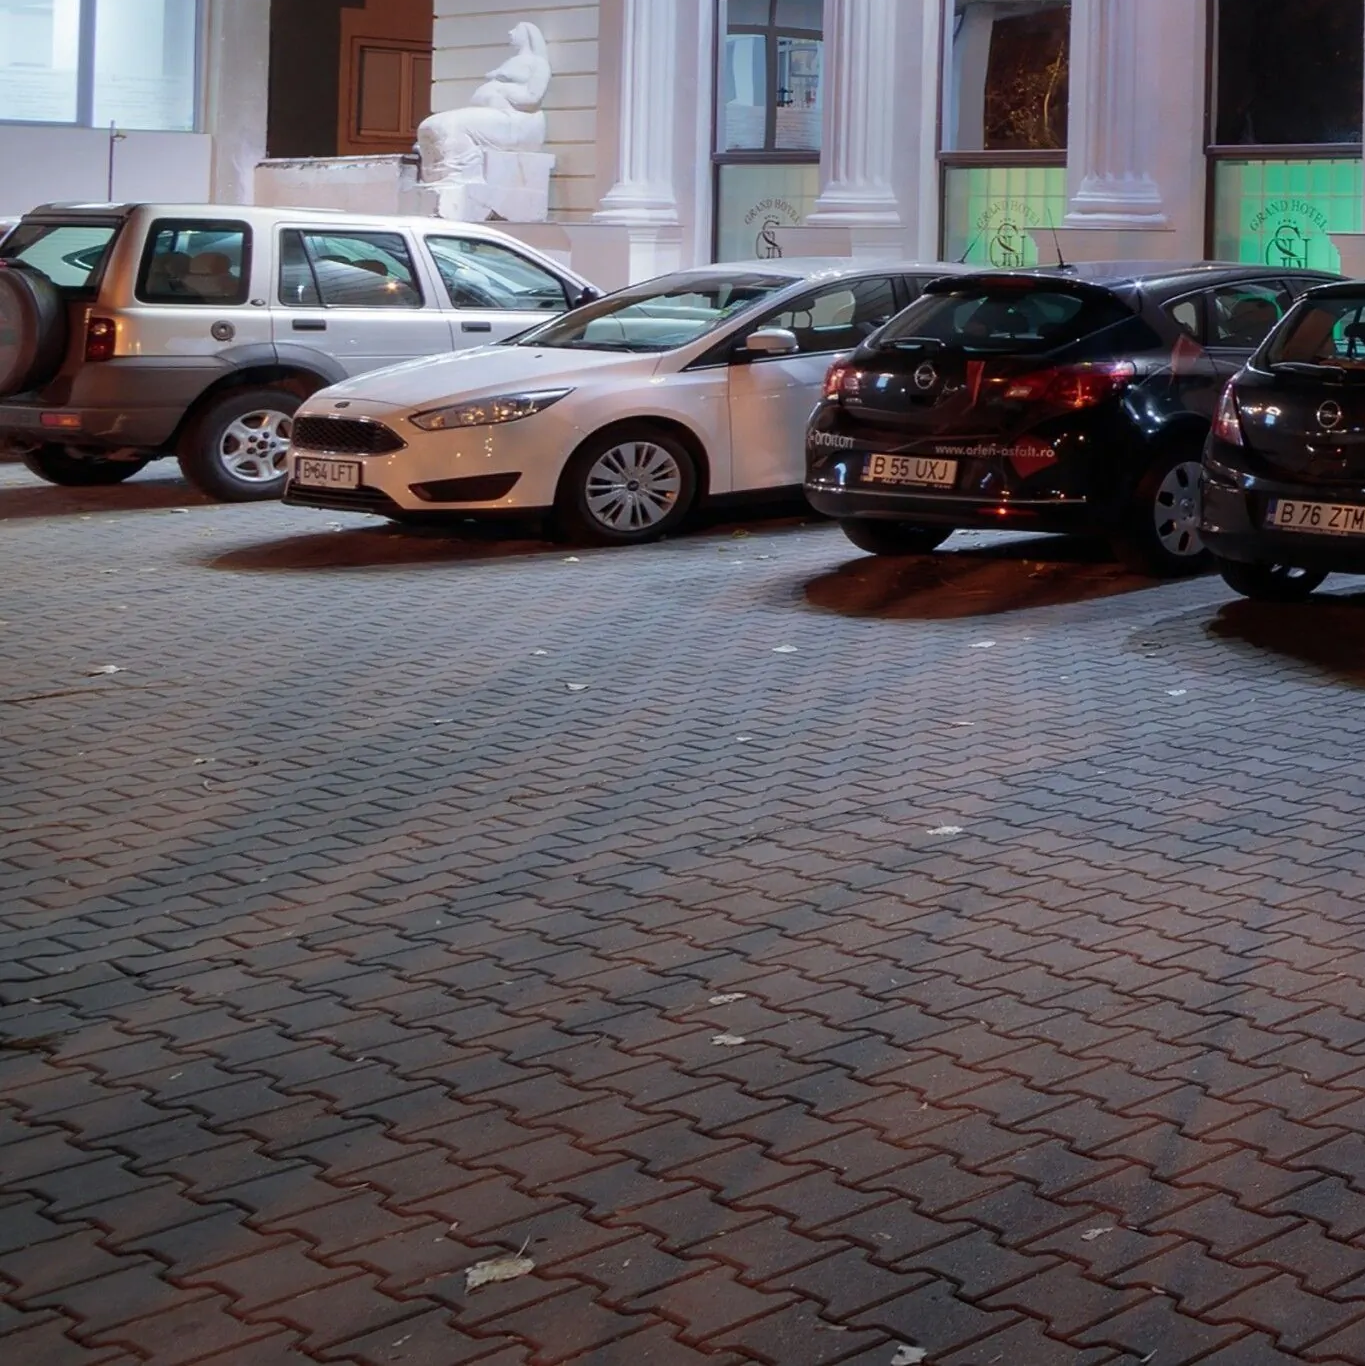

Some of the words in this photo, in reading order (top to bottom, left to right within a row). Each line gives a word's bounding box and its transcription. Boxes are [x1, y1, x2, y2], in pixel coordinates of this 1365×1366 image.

[744, 200, 772, 226] GRAND
[1249, 200, 1288, 232] GRAND
[1291, 200, 1327, 233] HOTEL
[331, 463, 354, 482] LFT
[873, 456, 885, 475] B
[890, 459, 909, 477] 55
[915, 460, 948, 481] UXJ
[1281, 502, 1295, 523] B
[1299, 504, 1321, 526] 76
[1328, 507, 1365, 530] ZTM
